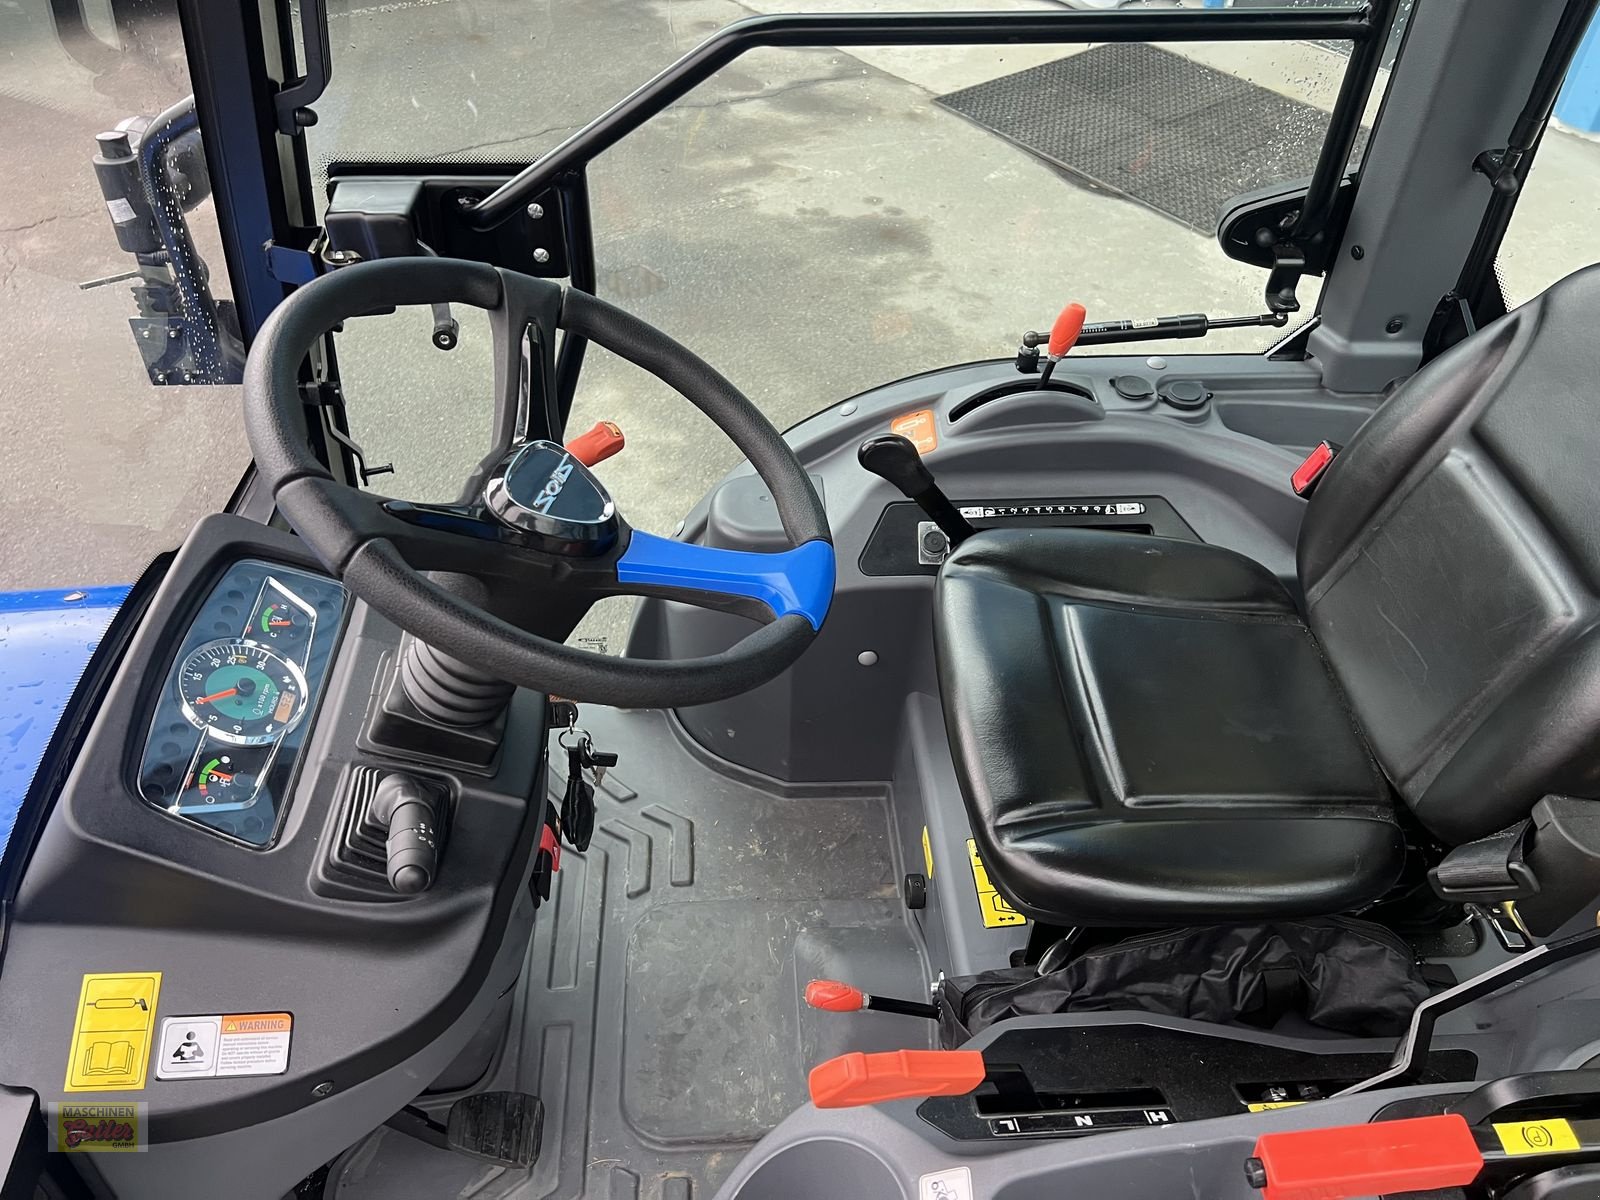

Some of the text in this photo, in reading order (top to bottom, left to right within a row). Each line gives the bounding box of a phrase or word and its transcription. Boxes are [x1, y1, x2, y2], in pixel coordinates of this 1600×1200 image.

[210, 658, 221, 668] 20
[226, 656, 236, 666] 25
[256, 661, 266, 671] 30
[192, 672, 203, 681] 15
[239, 1019, 284, 1031] WARNING
[1074, 1115, 1093, 1127] N
[1148, 1111, 1169, 1122] H
